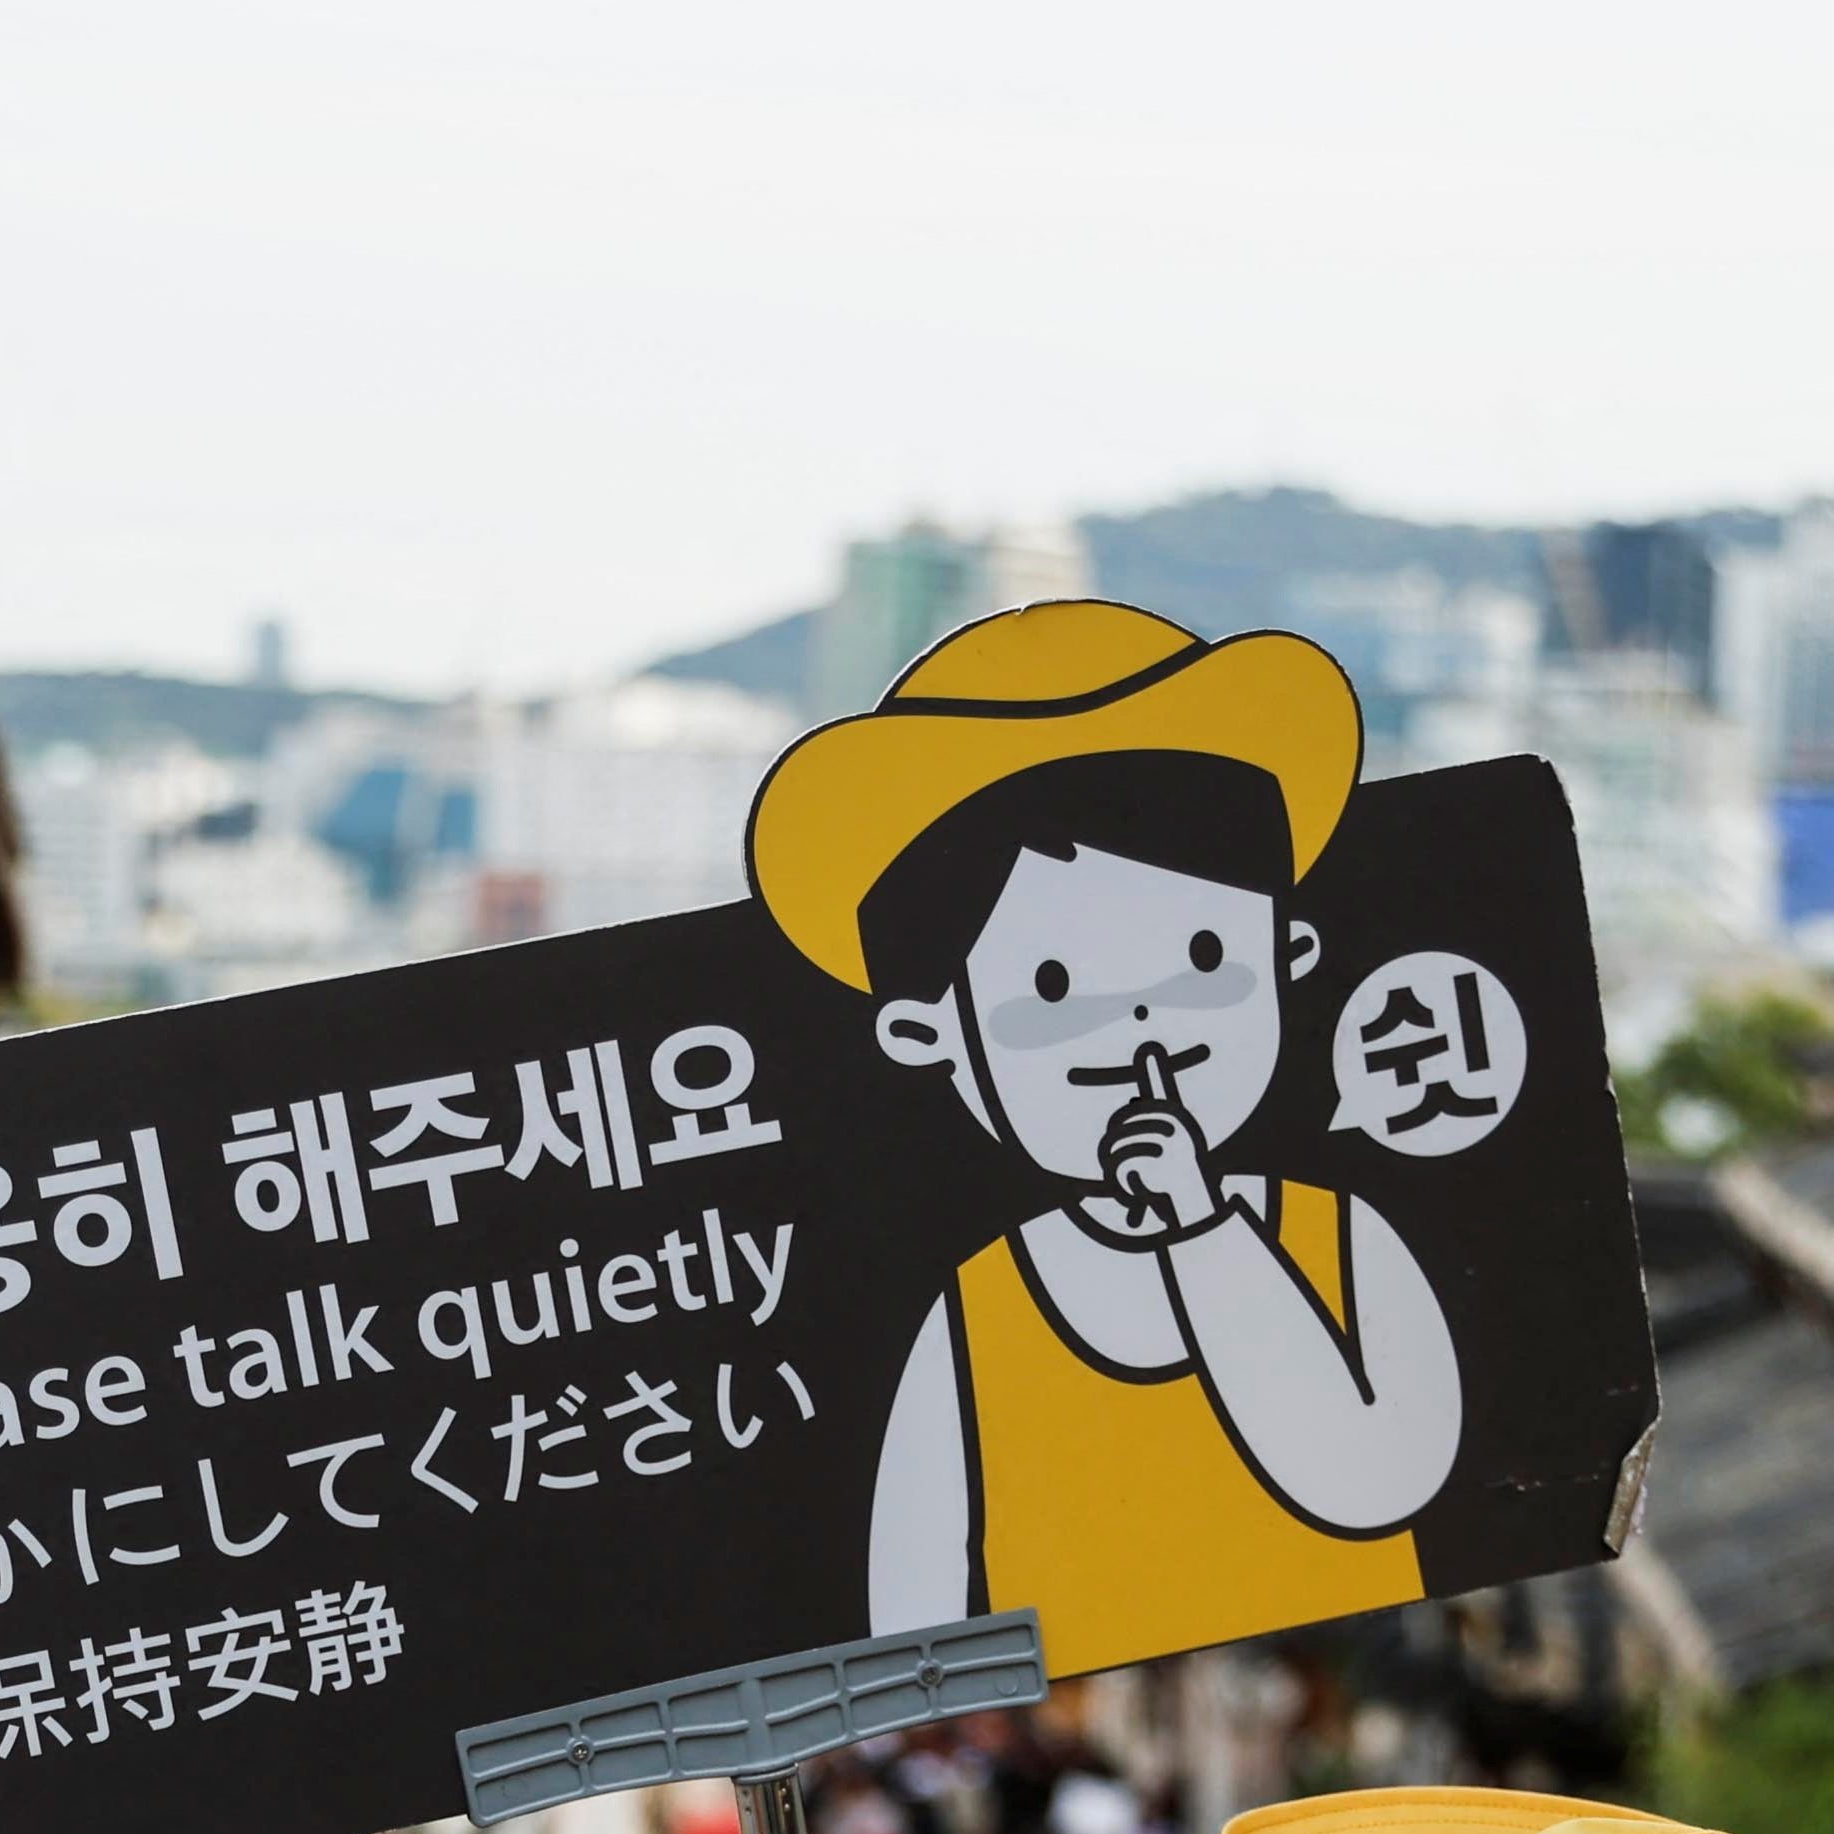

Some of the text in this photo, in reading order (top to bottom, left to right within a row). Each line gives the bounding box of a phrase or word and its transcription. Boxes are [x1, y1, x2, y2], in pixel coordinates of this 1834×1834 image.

[220, 1024, 783, 1244] 해주세요
[1359, 971, 1499, 1136] 쉿
[172, 1283, 395, 1408] talk
[417, 1223, 794, 1380] quietly
